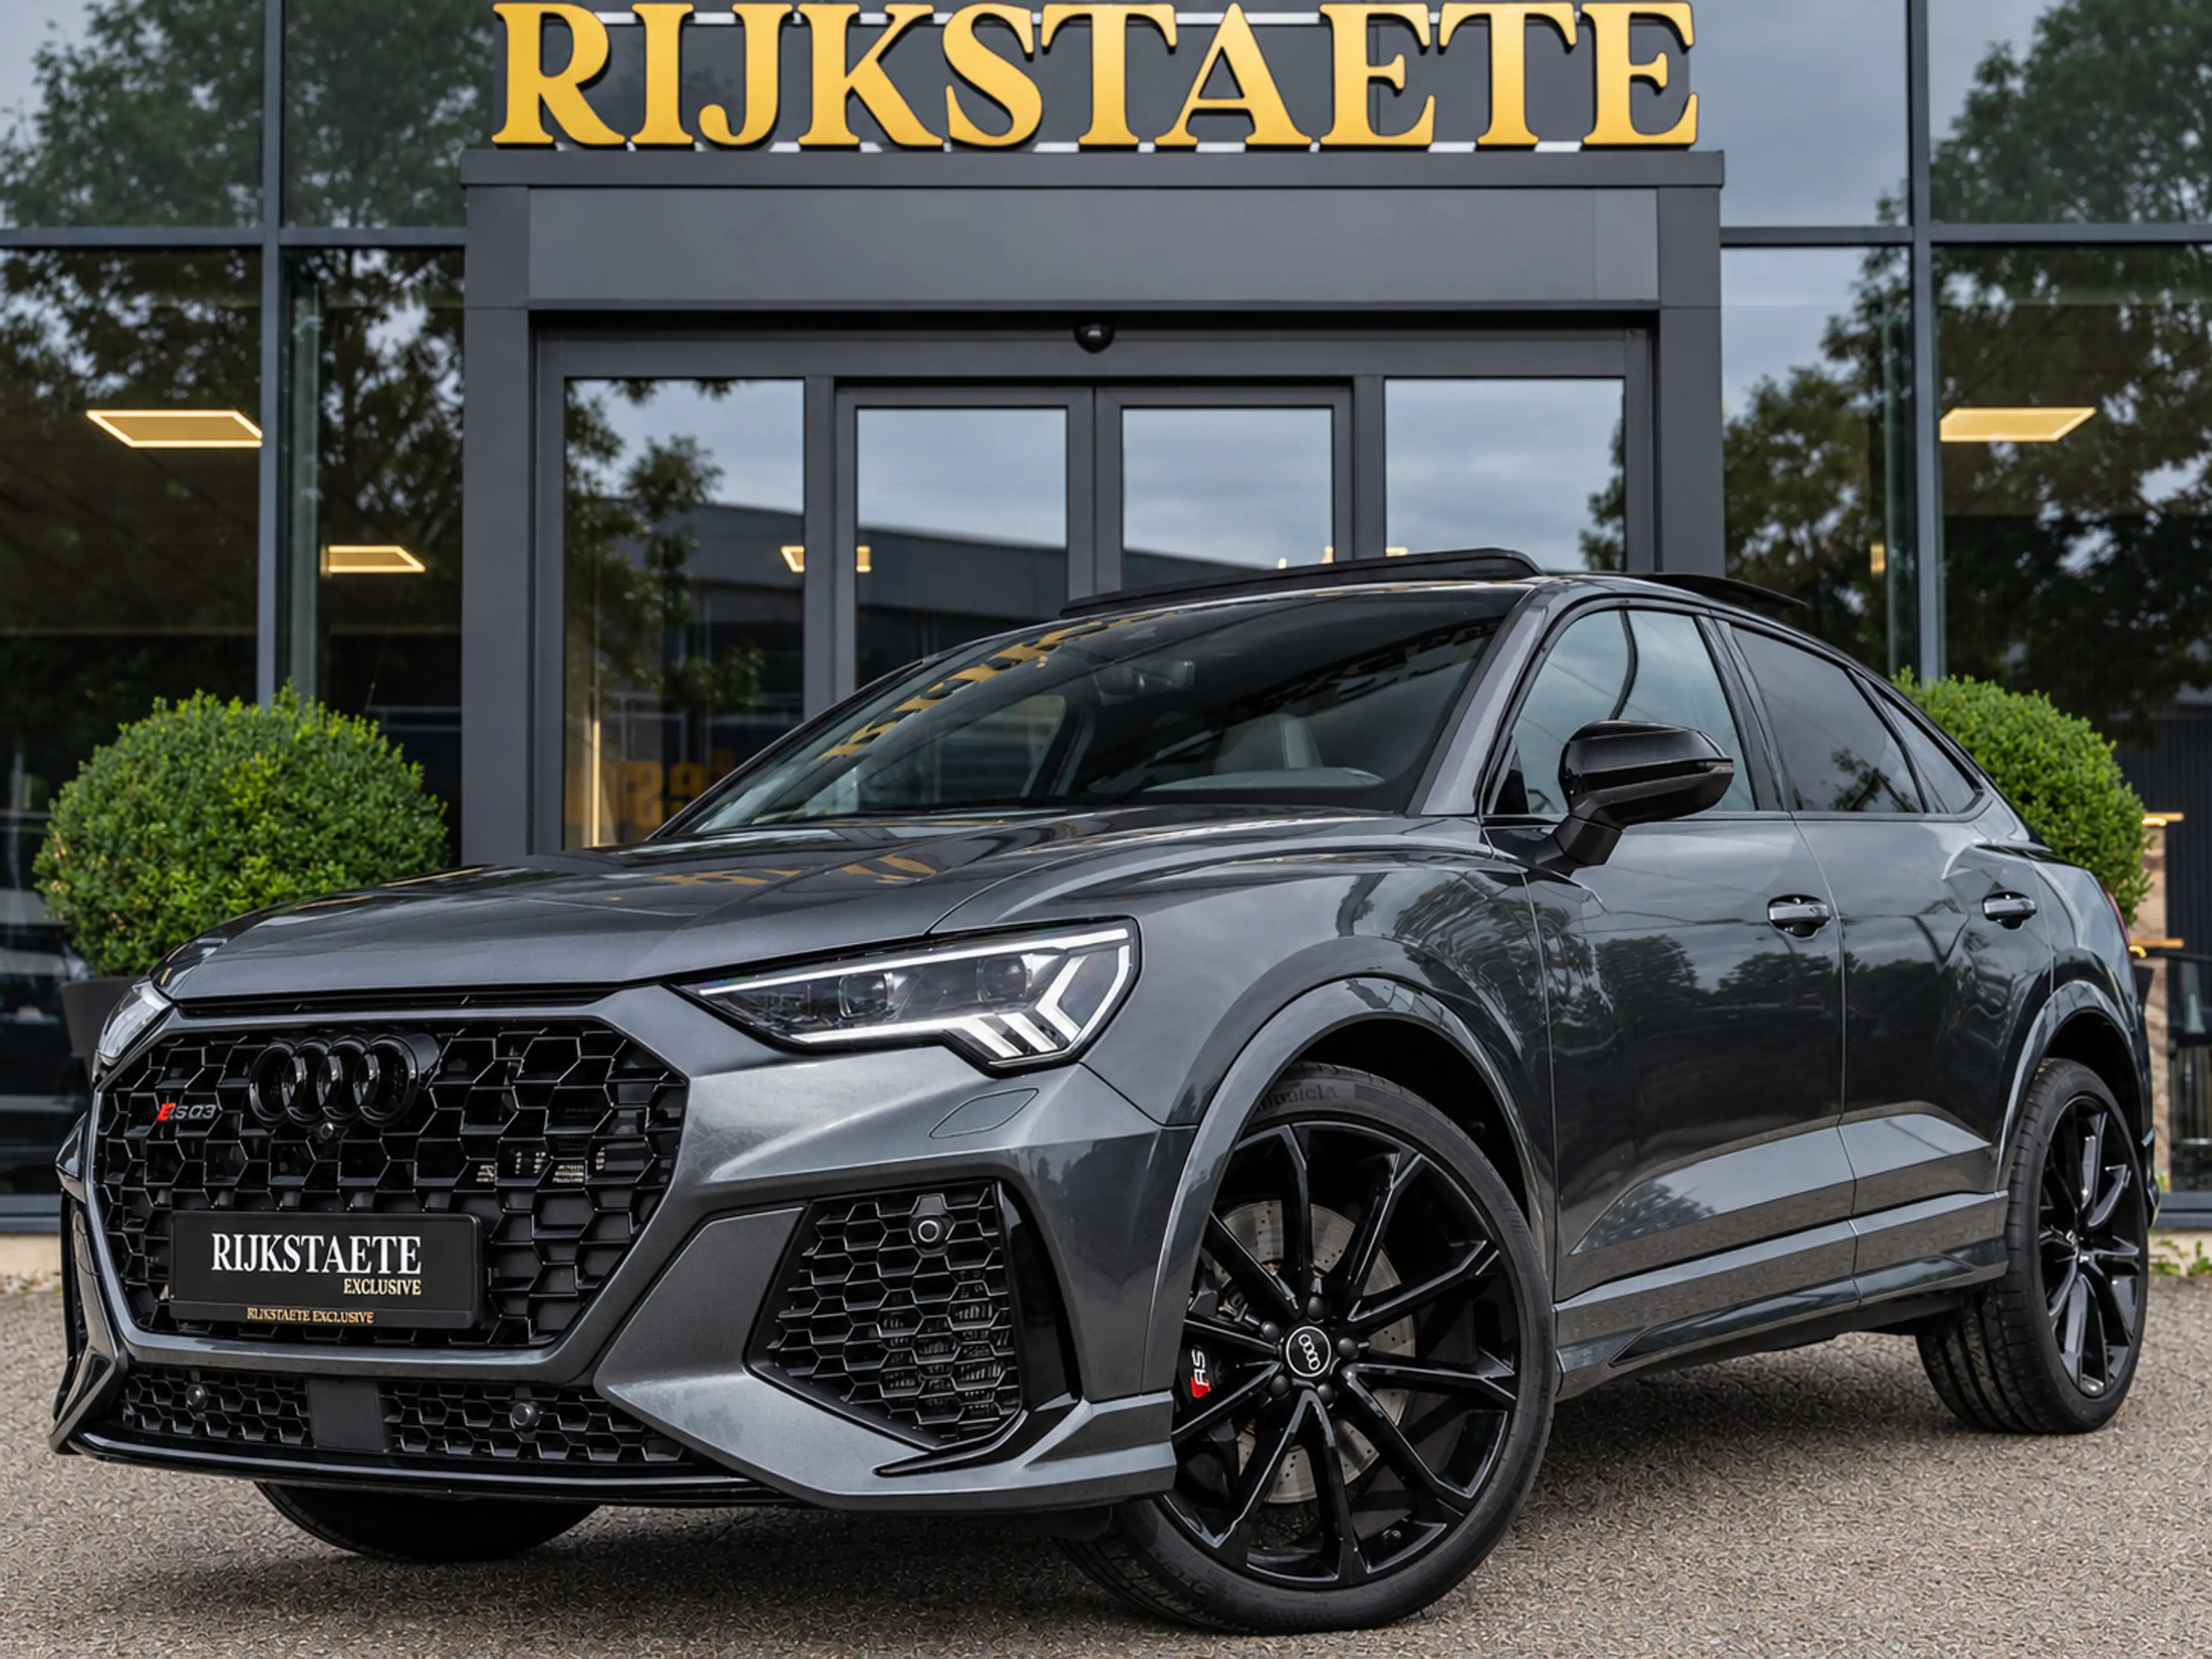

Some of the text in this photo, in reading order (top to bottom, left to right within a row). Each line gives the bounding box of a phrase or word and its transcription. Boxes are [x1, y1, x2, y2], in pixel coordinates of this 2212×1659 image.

[492, 2, 1698, 147] RIJKSTAETE
[211, 1233, 421, 1274] RIJKSTAETE
[343, 1278, 422, 1295] EXCLUSIVE
